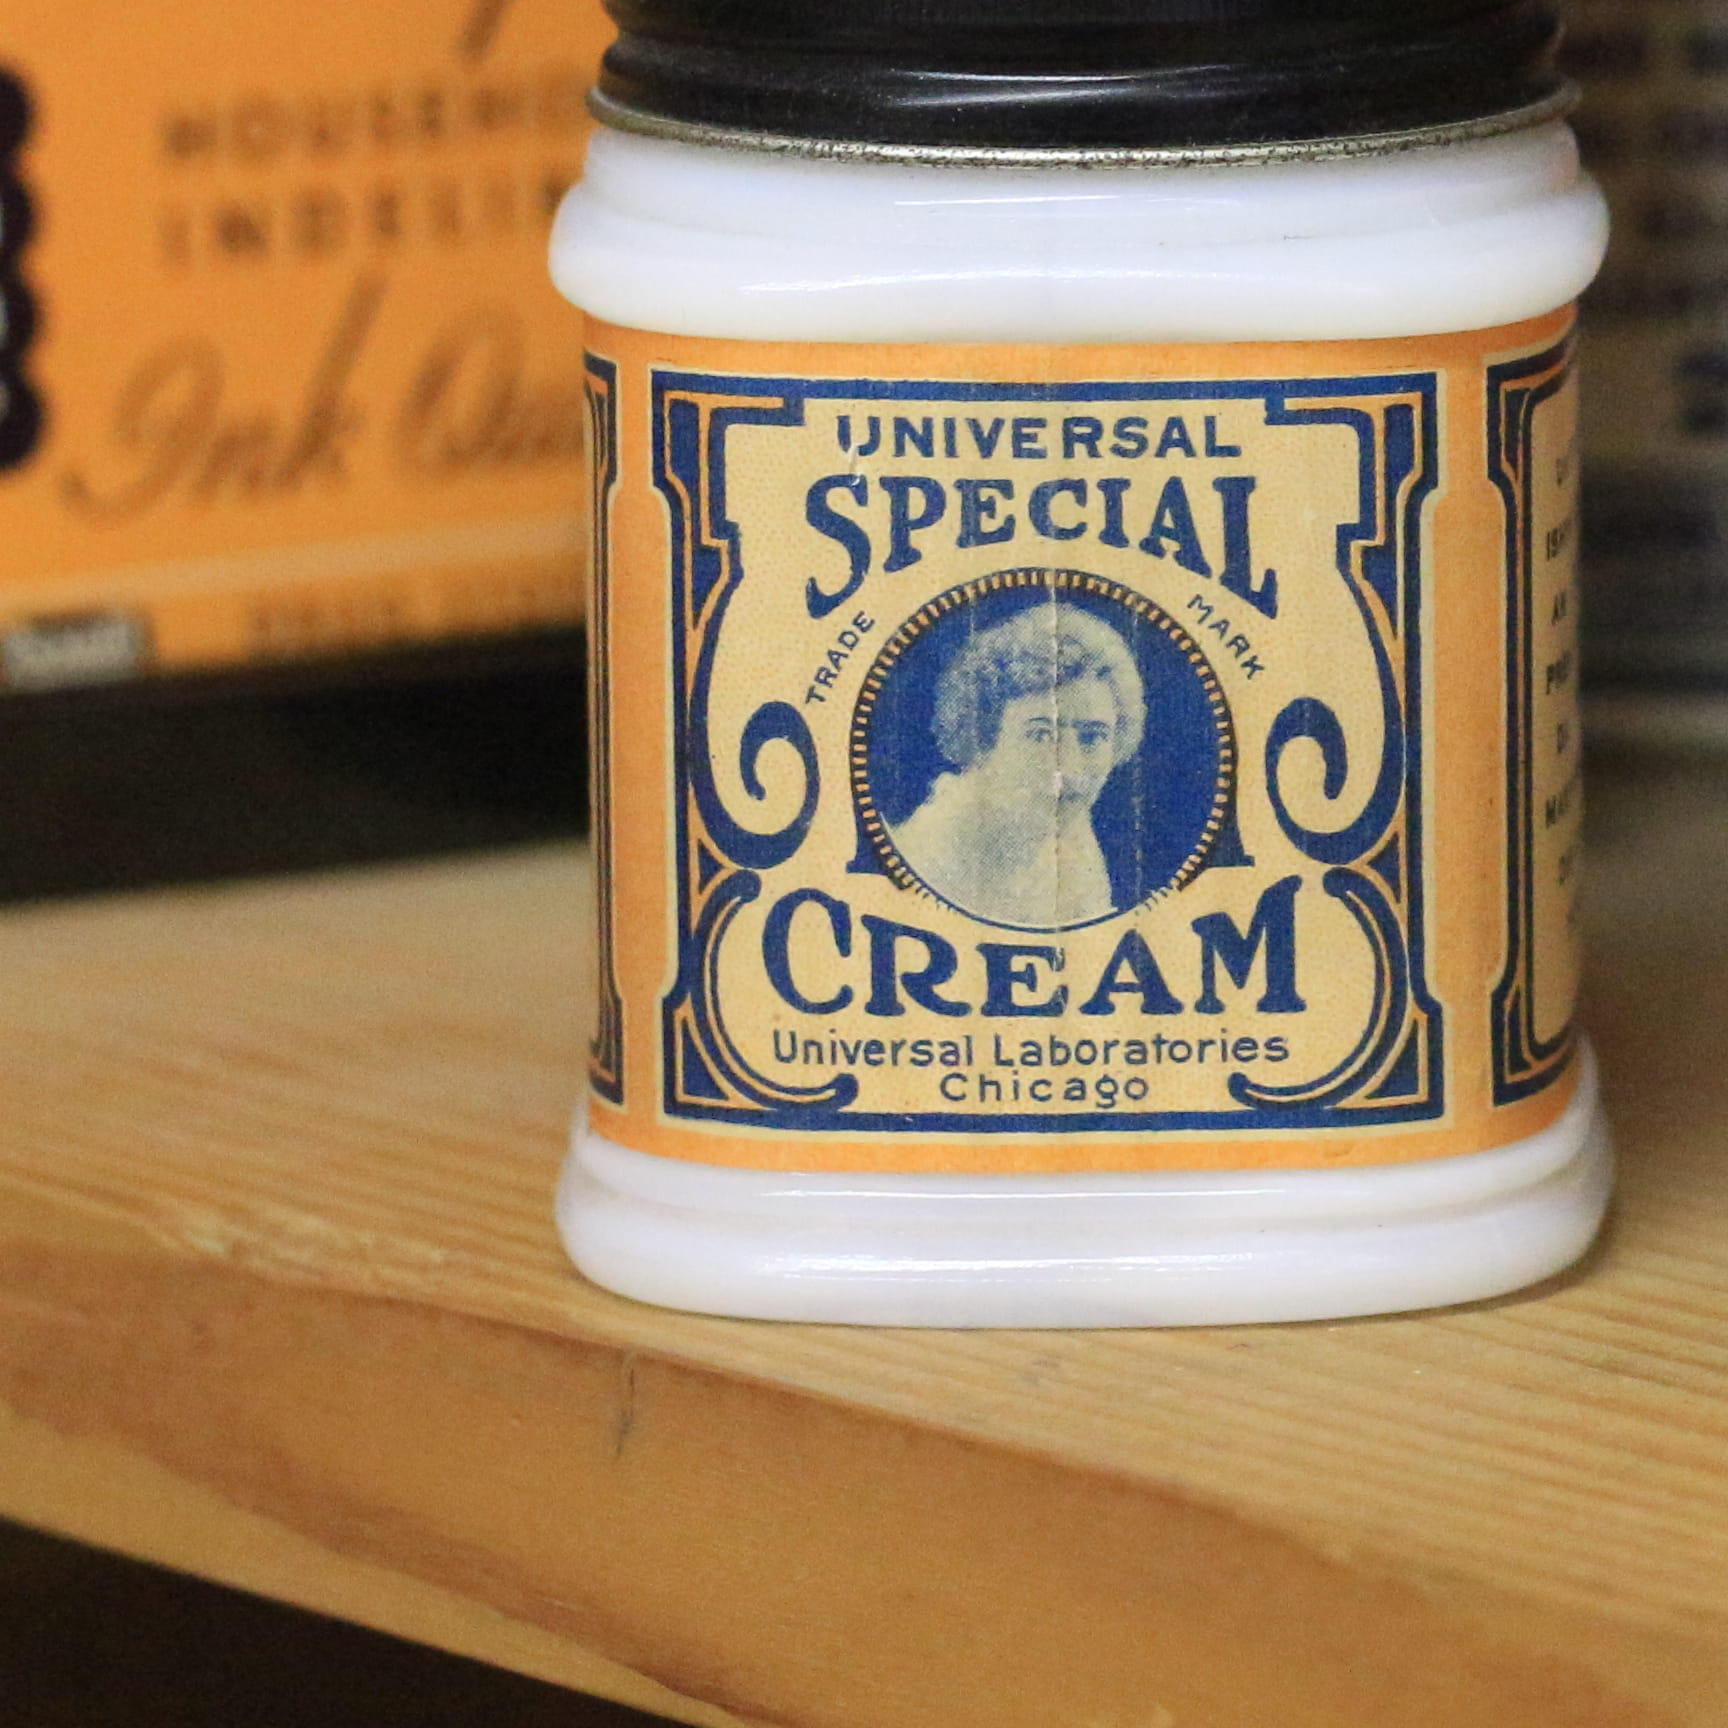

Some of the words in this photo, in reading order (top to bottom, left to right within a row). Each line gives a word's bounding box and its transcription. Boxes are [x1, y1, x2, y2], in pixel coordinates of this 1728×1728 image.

[838, 415, 1241, 460] UNIVERSAL
[805, 474, 1279, 620] SPECIAL
[805, 610, 876, 704] TRADE
[1186, 594, 1265, 680] MARK
[761, 874, 1307, 1018] CREAM
[772, 1030, 974, 1069] Universal
[993, 1029, 1291, 1068] Laboratories
[940, 1072, 1149, 1110] Chicago
